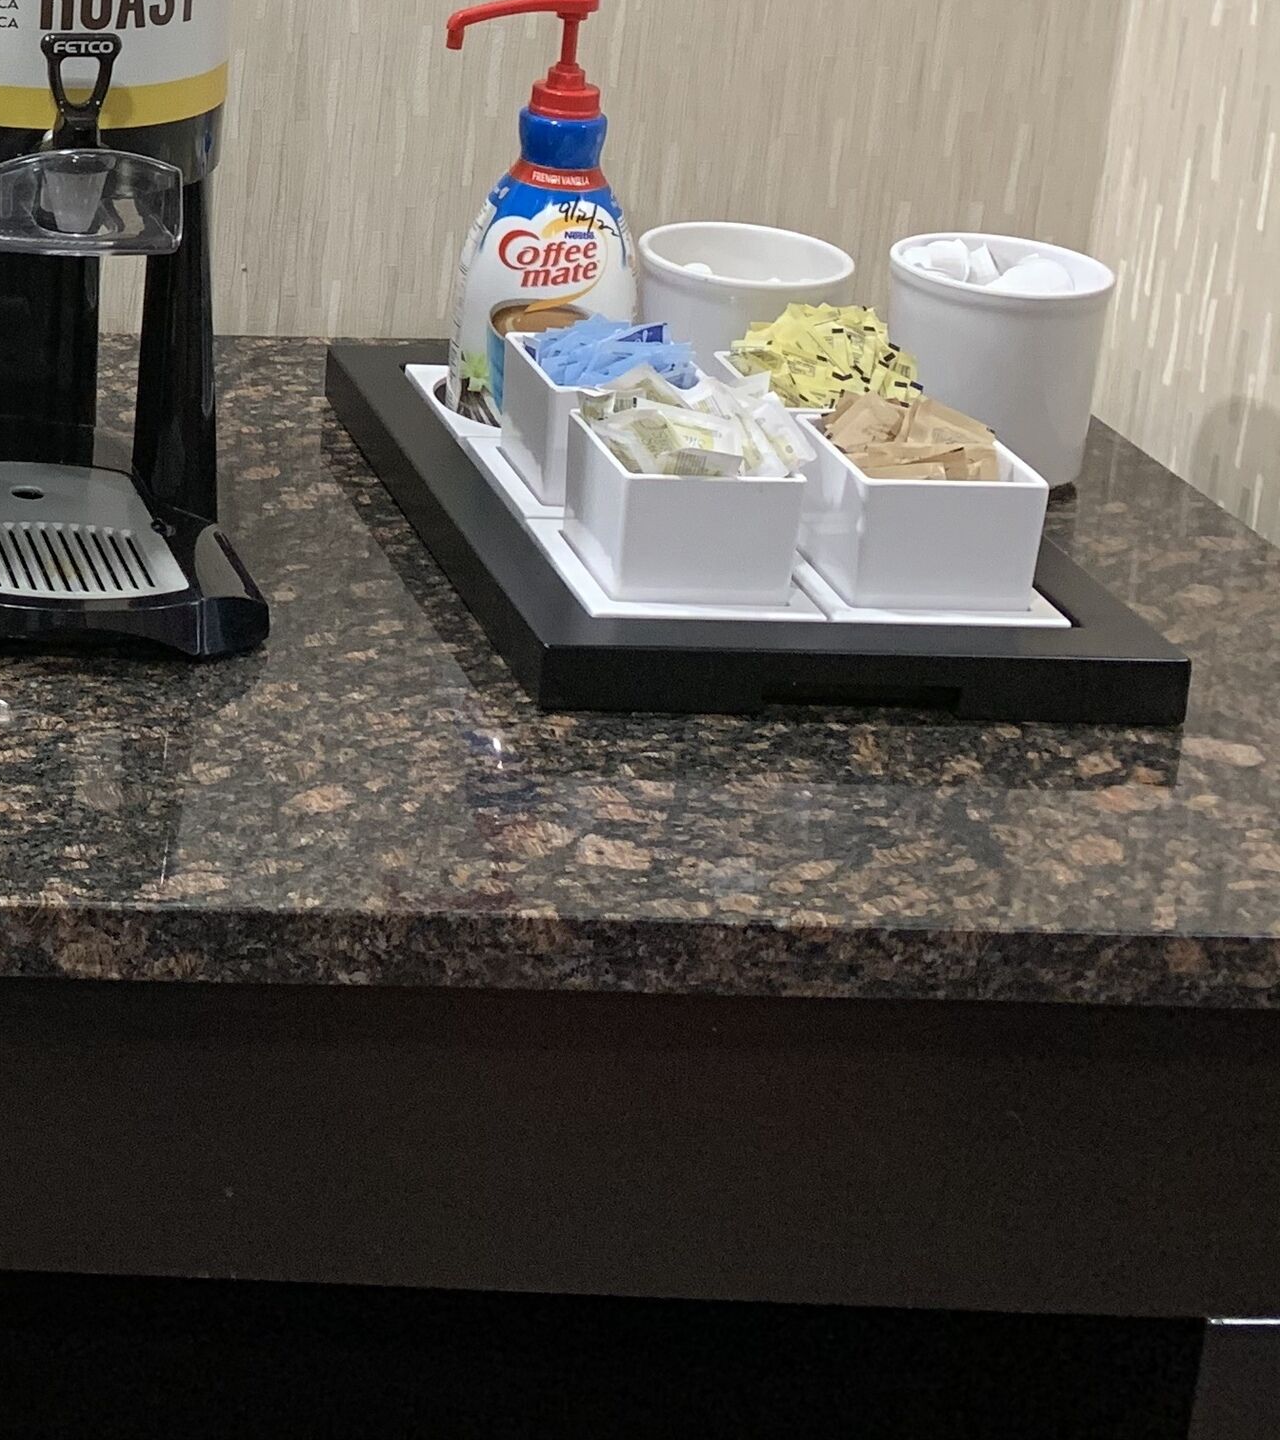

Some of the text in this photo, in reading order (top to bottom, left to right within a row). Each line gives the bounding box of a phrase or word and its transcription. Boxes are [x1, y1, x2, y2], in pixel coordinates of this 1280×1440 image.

[52, 40, 115, 56] FETCO
[531, 170, 590, 187] FRENCH VANILLA
[498, 228, 598, 271] Coffee
[520, 260, 599, 288] mate
